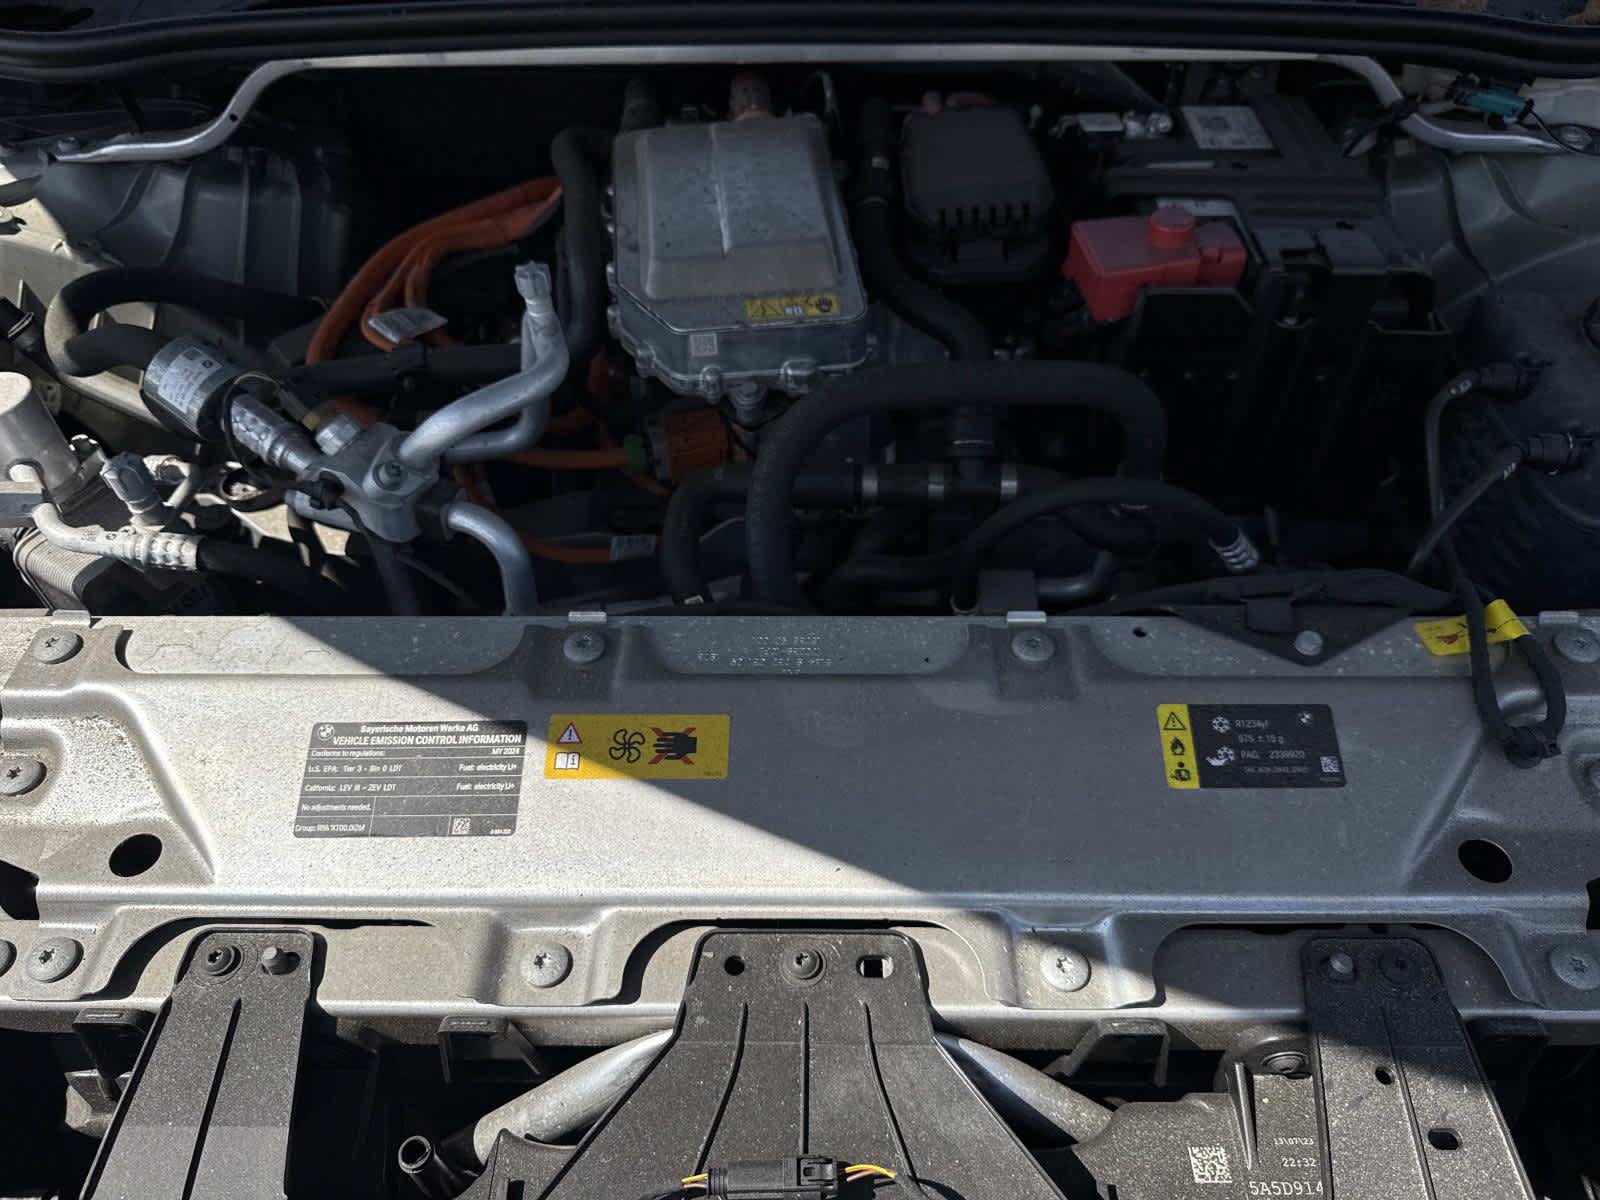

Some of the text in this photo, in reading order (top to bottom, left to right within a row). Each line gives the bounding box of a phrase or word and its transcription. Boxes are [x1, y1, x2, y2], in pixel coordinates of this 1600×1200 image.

[360, 723, 479, 735] Bayerische Motoren Werke AG
[333, 734, 522, 745] VEHICLE EMISSION CONTROL INFORMATION
[474, 782, 505, 791] electricity
[1282, 1157, 1317, 1168] 22:32
